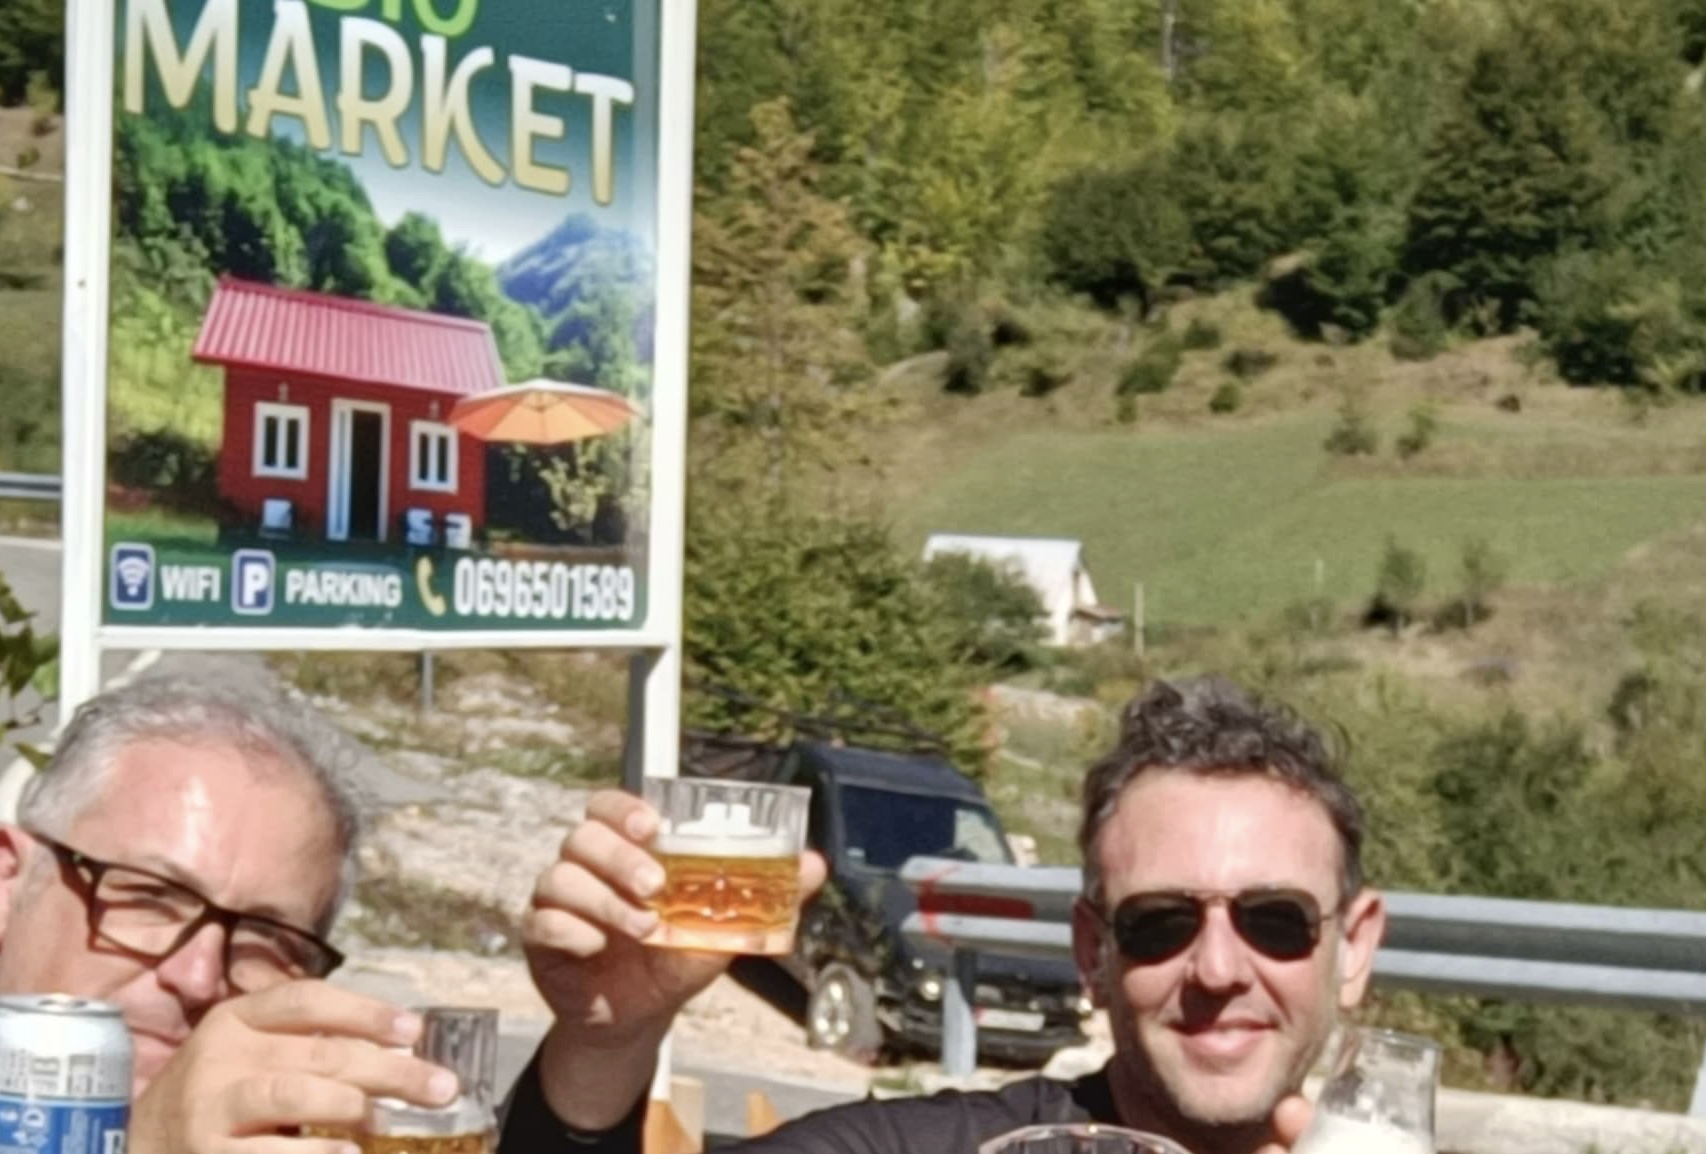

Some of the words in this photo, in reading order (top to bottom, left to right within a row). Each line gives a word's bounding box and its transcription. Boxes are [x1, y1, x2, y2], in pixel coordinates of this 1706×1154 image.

[124, 0, 635, 206] MARKET
[160, 565, 221, 602] WIFI
[243, 562, 270, 605] P
[285, 569, 403, 607] PARKING
[454, 557, 635, 620] 0696501589
